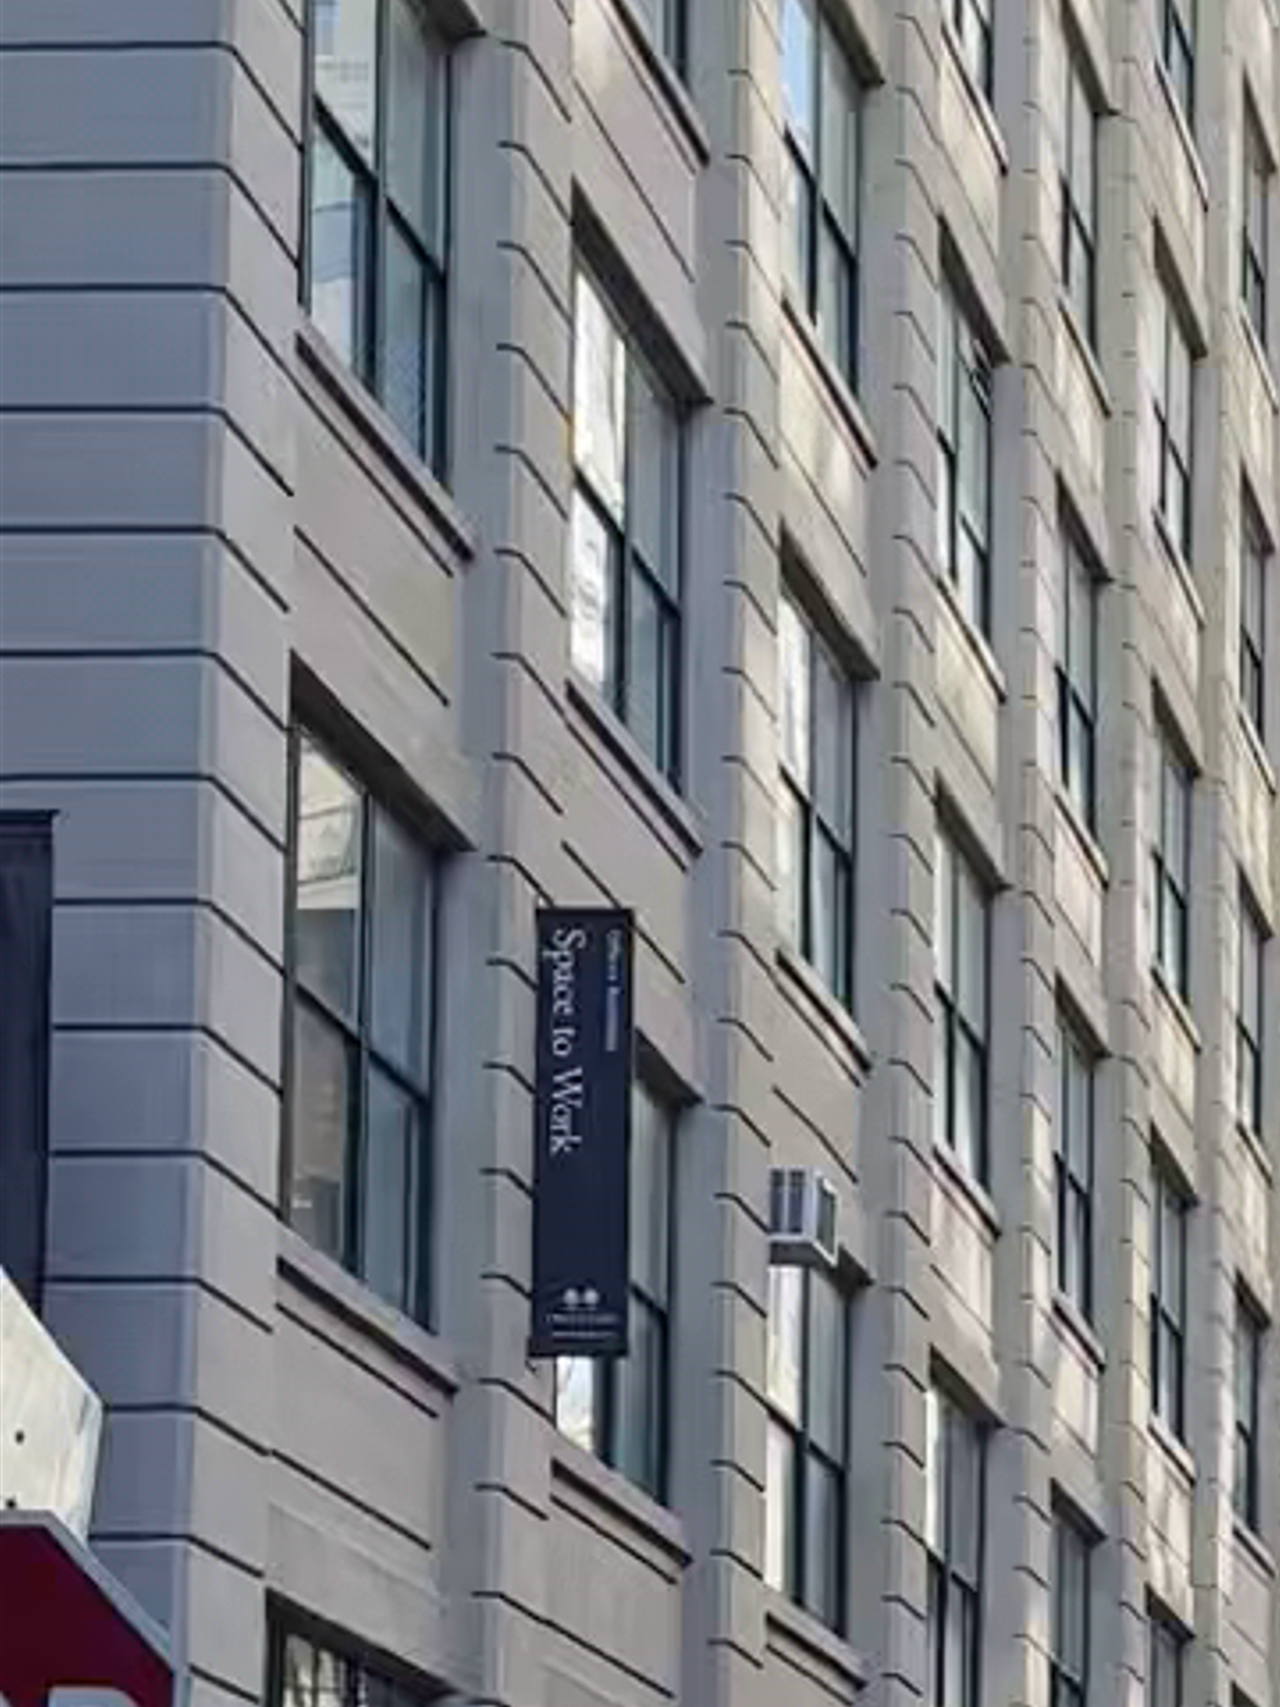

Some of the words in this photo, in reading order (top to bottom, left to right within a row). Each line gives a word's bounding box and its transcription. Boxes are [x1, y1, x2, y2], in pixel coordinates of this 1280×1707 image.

[542, 928, 587, 1016] Space
[551, 1027, 576, 1058] to
[551, 1065, 584, 1157] Work
